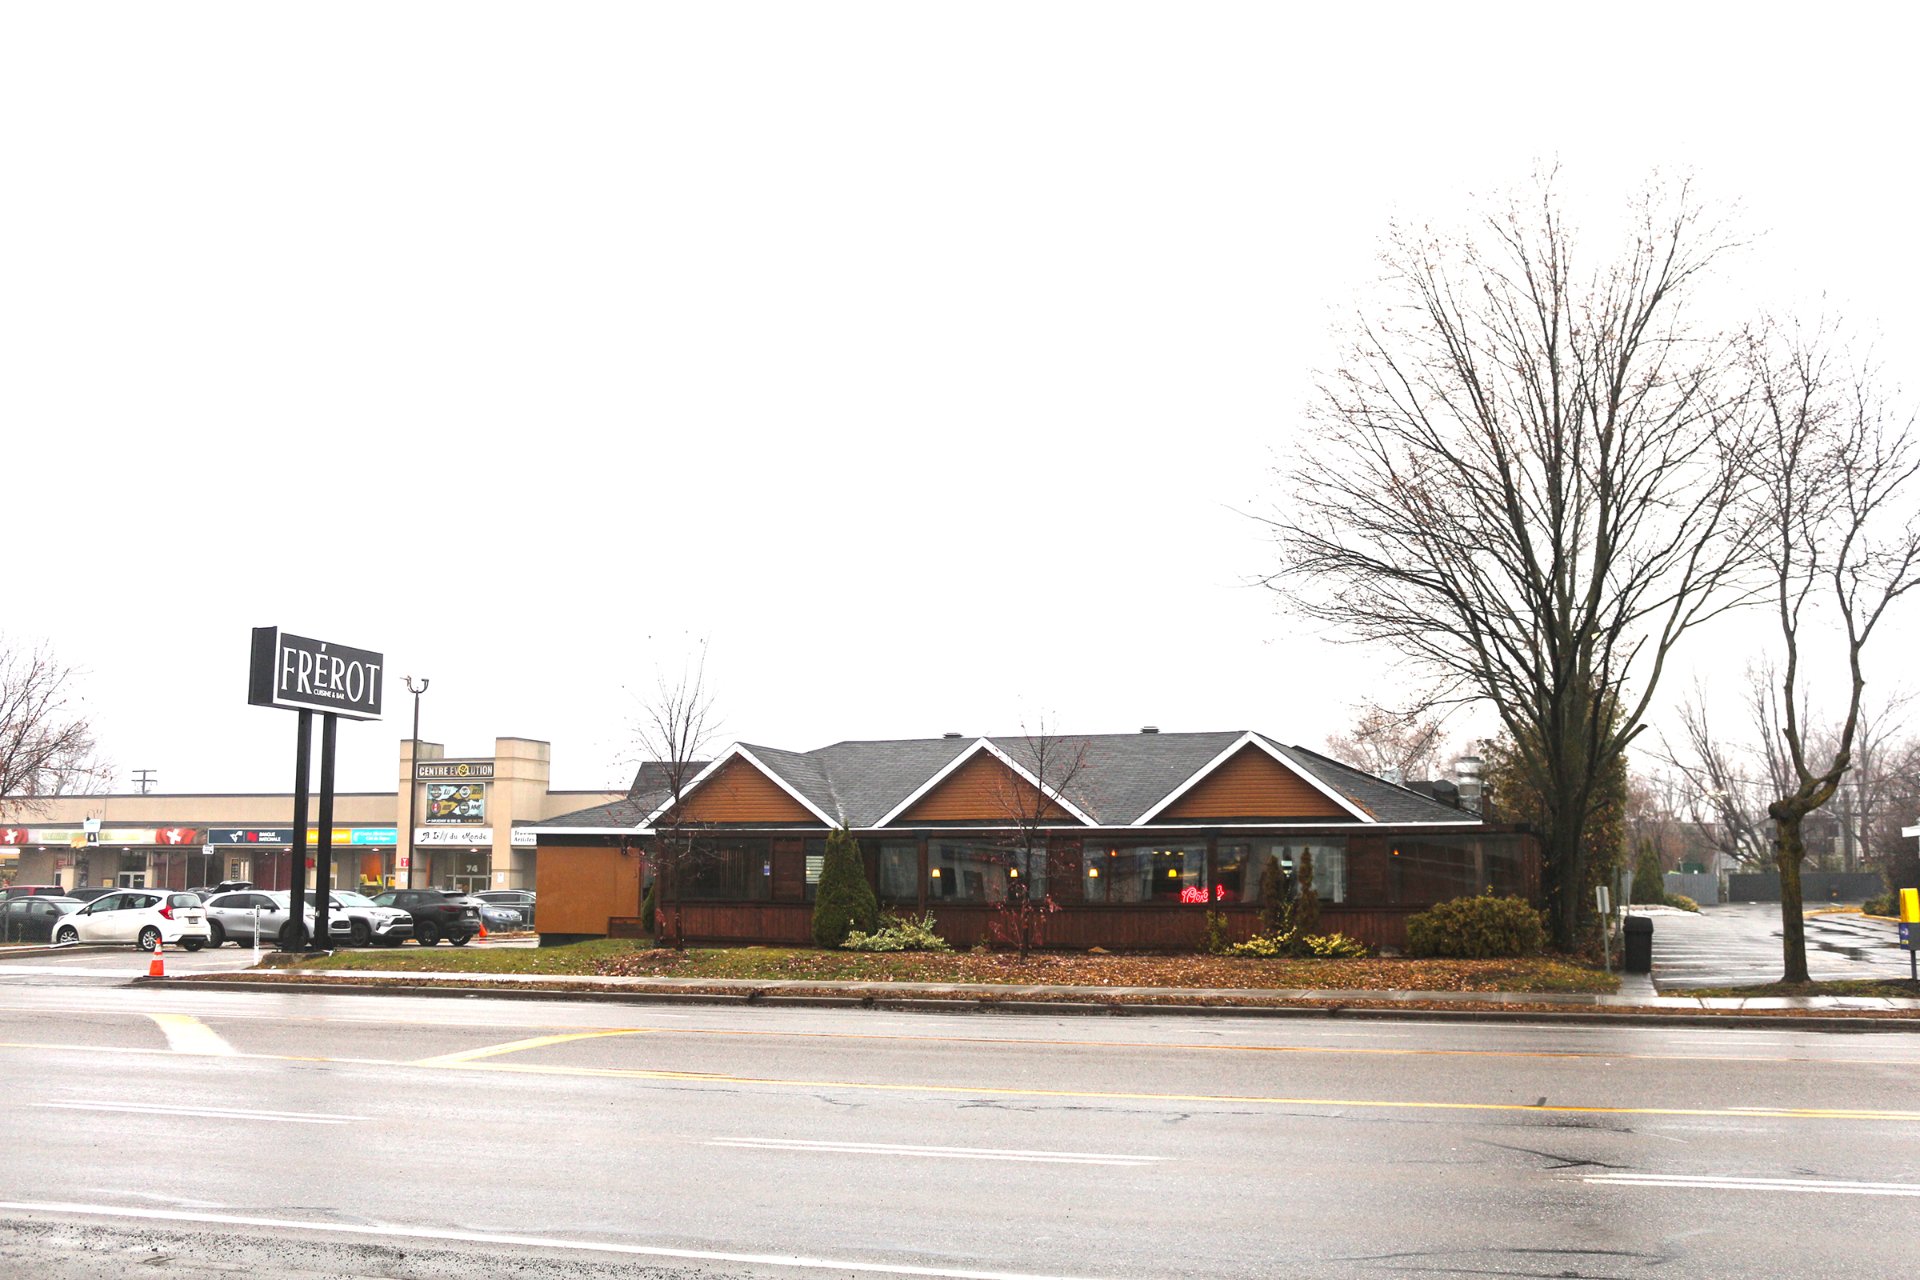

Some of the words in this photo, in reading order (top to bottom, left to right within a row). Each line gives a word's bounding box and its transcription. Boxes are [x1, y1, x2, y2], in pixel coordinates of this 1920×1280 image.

[281, 643, 380, 705] FRÉROT
[313, 688, 332, 698] CUISINE
[336, 692, 345, 700] BAR
[419, 766, 448, 776] CENTRE
[466, 864, 478, 873] 74
